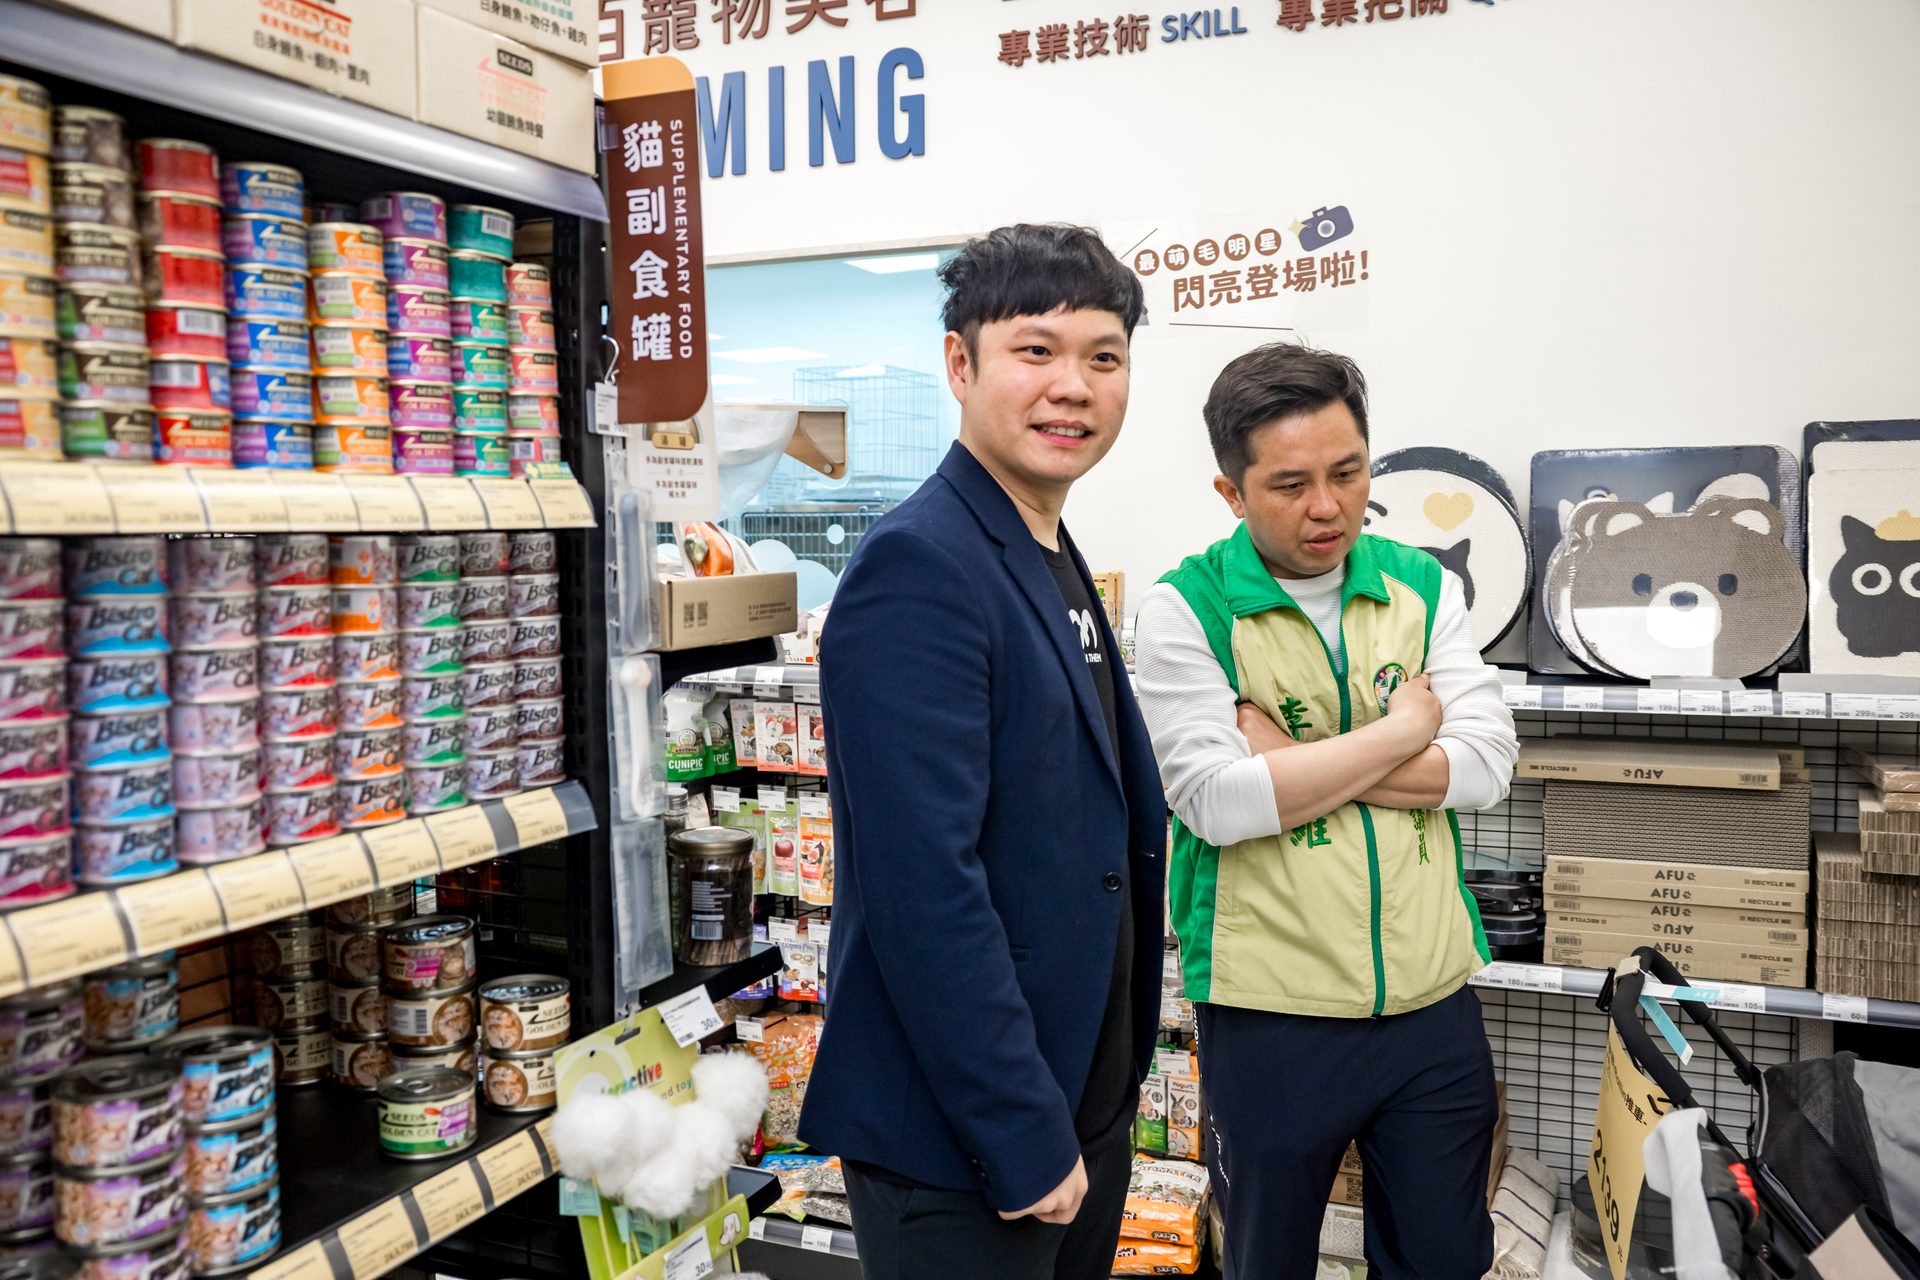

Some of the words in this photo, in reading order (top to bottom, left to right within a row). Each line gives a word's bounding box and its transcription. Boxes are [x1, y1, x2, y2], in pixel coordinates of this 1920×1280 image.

[997, 14, 1151, 67] 專業技術
[1161, 6, 1248, 43] SKILL
[669, 118, 692, 295] SUPPLEMENTARY
[622, 120, 674, 362] 貓副食罐
[1138, 231, 1279, 272] 最萌毛明星
[1173, 250, 1369, 313] 閃亮登場啦!
[678, 303, 692, 360] FOOD
[514, 624, 557, 643] Bistro
[514, 665, 557, 684] Bistro
[517, 706, 559, 725] Bistro
[668, 758, 704, 770] CUNIPIC
[1634, 768, 1664, 780] AFU
[1655, 870, 1685, 881] AFU
[1650, 888, 1681, 900] AFU
[1747, 898, 1780, 907] RECYCLE
[1650, 905, 1680, 917] AFU
[1747, 916, 1780, 924] RECYCLE
[1663, 923, 1694, 935] AFU
[1653, 942, 1682, 954] AFU
[1749, 953, 1781, 962] RECYCLE
[1171, 1081, 1194, 1090] Yogurt
